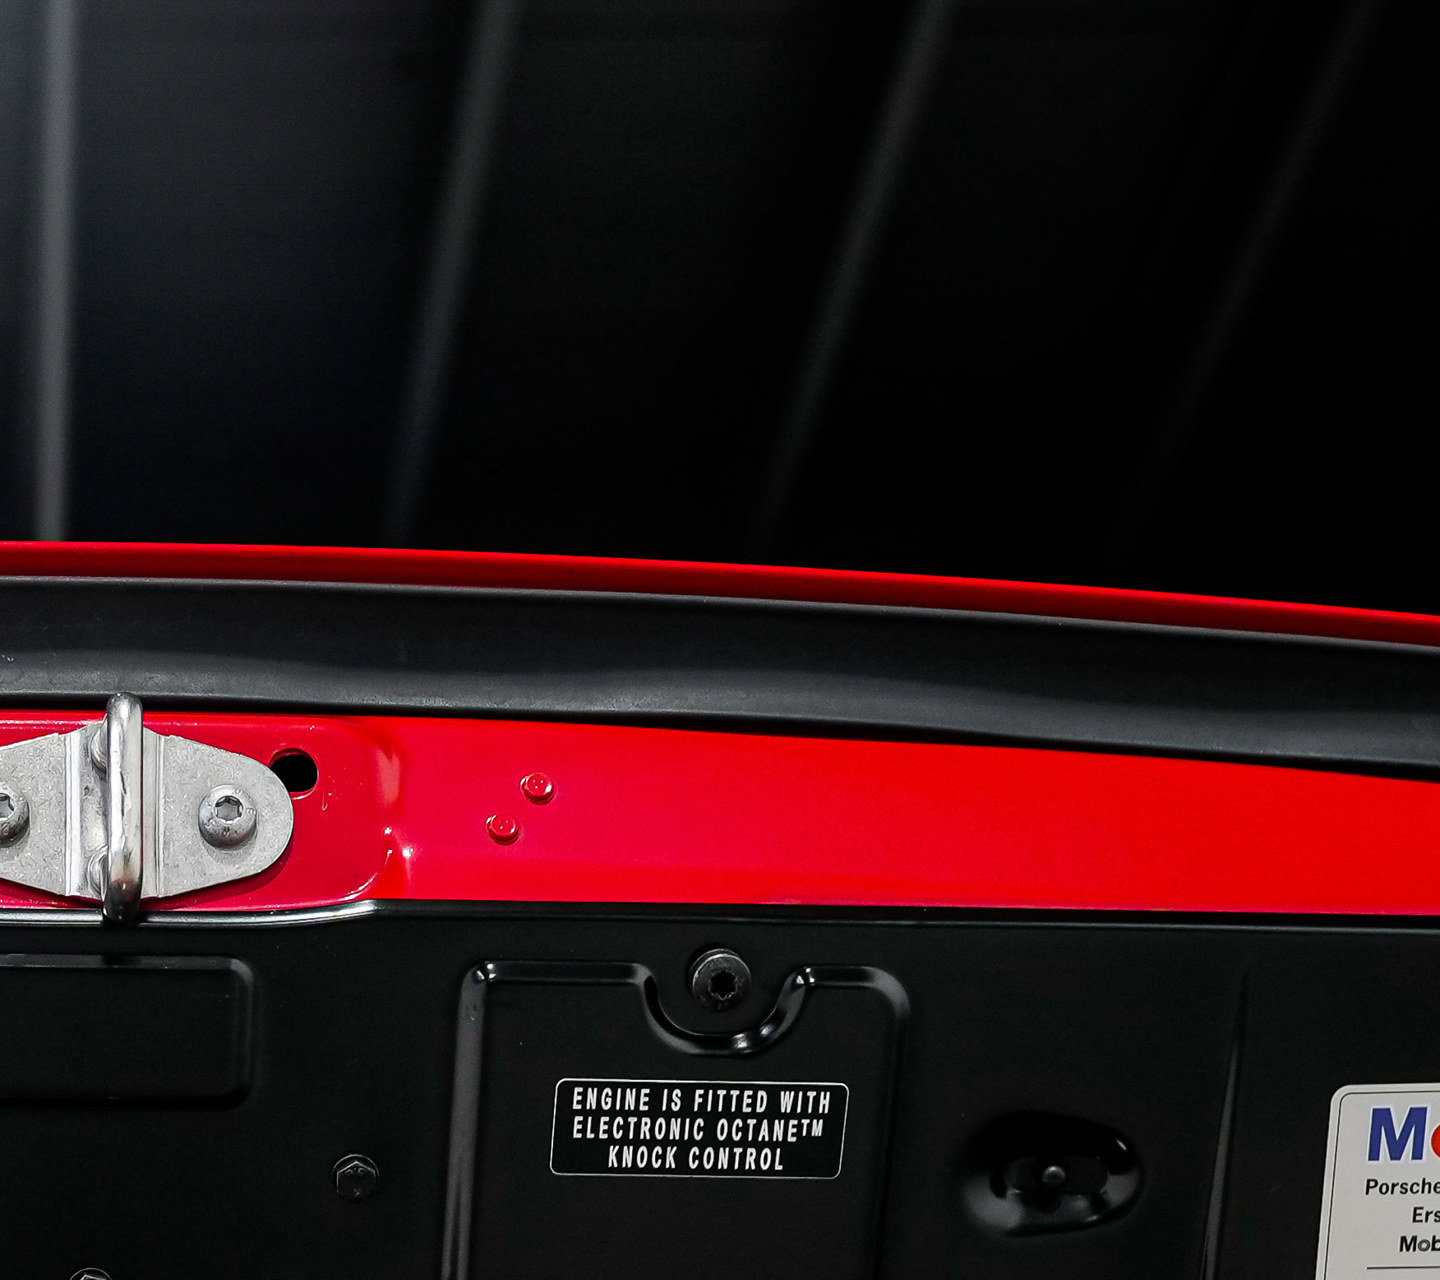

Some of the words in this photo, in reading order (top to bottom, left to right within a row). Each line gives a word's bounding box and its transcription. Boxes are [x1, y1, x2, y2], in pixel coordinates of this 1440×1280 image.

[573, 1087, 650, 1111] ENGINE
[662, 1089, 681, 1111] IS
[694, 1089, 767, 1113] FITTED
[781, 1091, 830, 1114] WITH
[573, 1116, 704, 1140] ELECTRONIC
[608, 1145, 677, 1168] KNOCK
[689, 1146, 783, 1170] CONTROL
